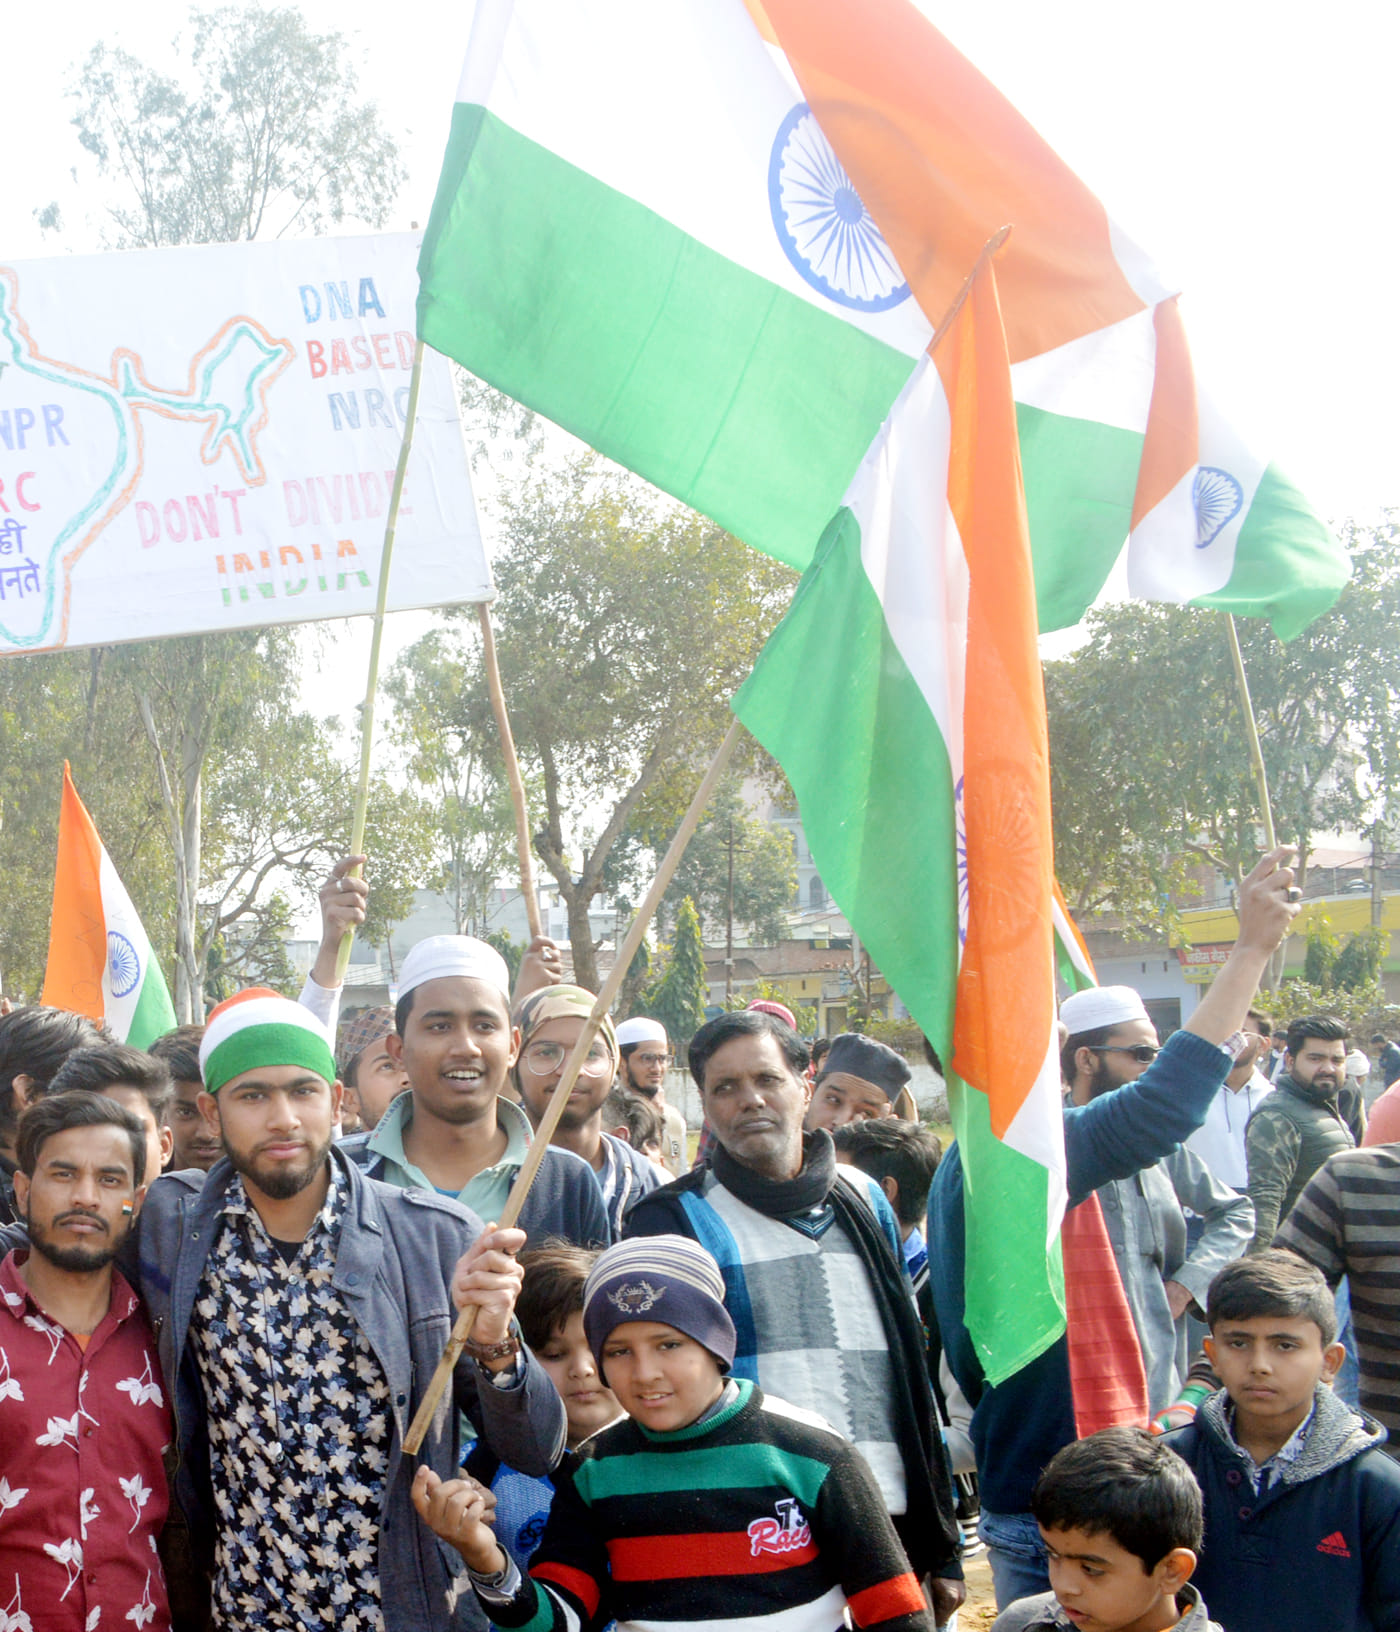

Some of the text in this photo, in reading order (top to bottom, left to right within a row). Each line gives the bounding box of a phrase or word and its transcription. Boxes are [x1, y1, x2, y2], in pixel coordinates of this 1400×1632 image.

[299, 277, 386, 324] DNA
[306, 330, 416, 379] BASED
[328, 386, 420, 430] NRC
[135, 485, 247, 549] DON'T
[215, 539, 372, 606] INDIA
